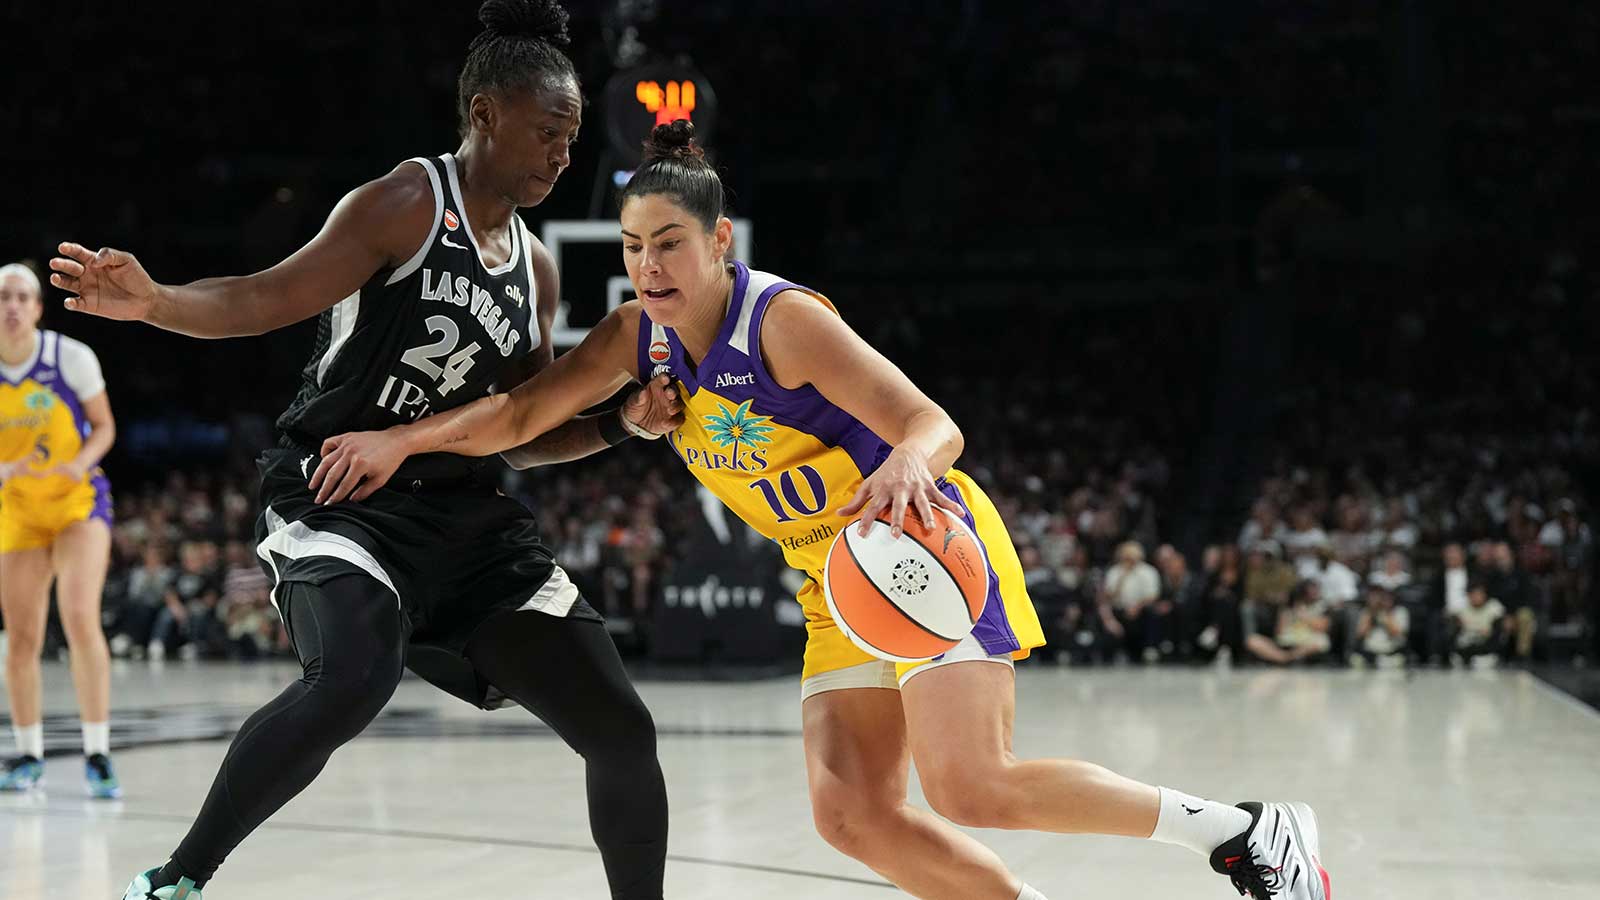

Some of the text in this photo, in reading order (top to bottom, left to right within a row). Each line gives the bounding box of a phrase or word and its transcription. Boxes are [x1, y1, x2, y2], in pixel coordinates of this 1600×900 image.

[421, 268, 520, 357] LAS VEGAS
[505, 285, 524, 308] ally
[400, 315, 482, 397] 24
[715, 372, 755, 388] Albert
[677, 432, 768, 474] PARKS
[749, 464, 828, 523] 10
[781, 524, 834, 550] Health
